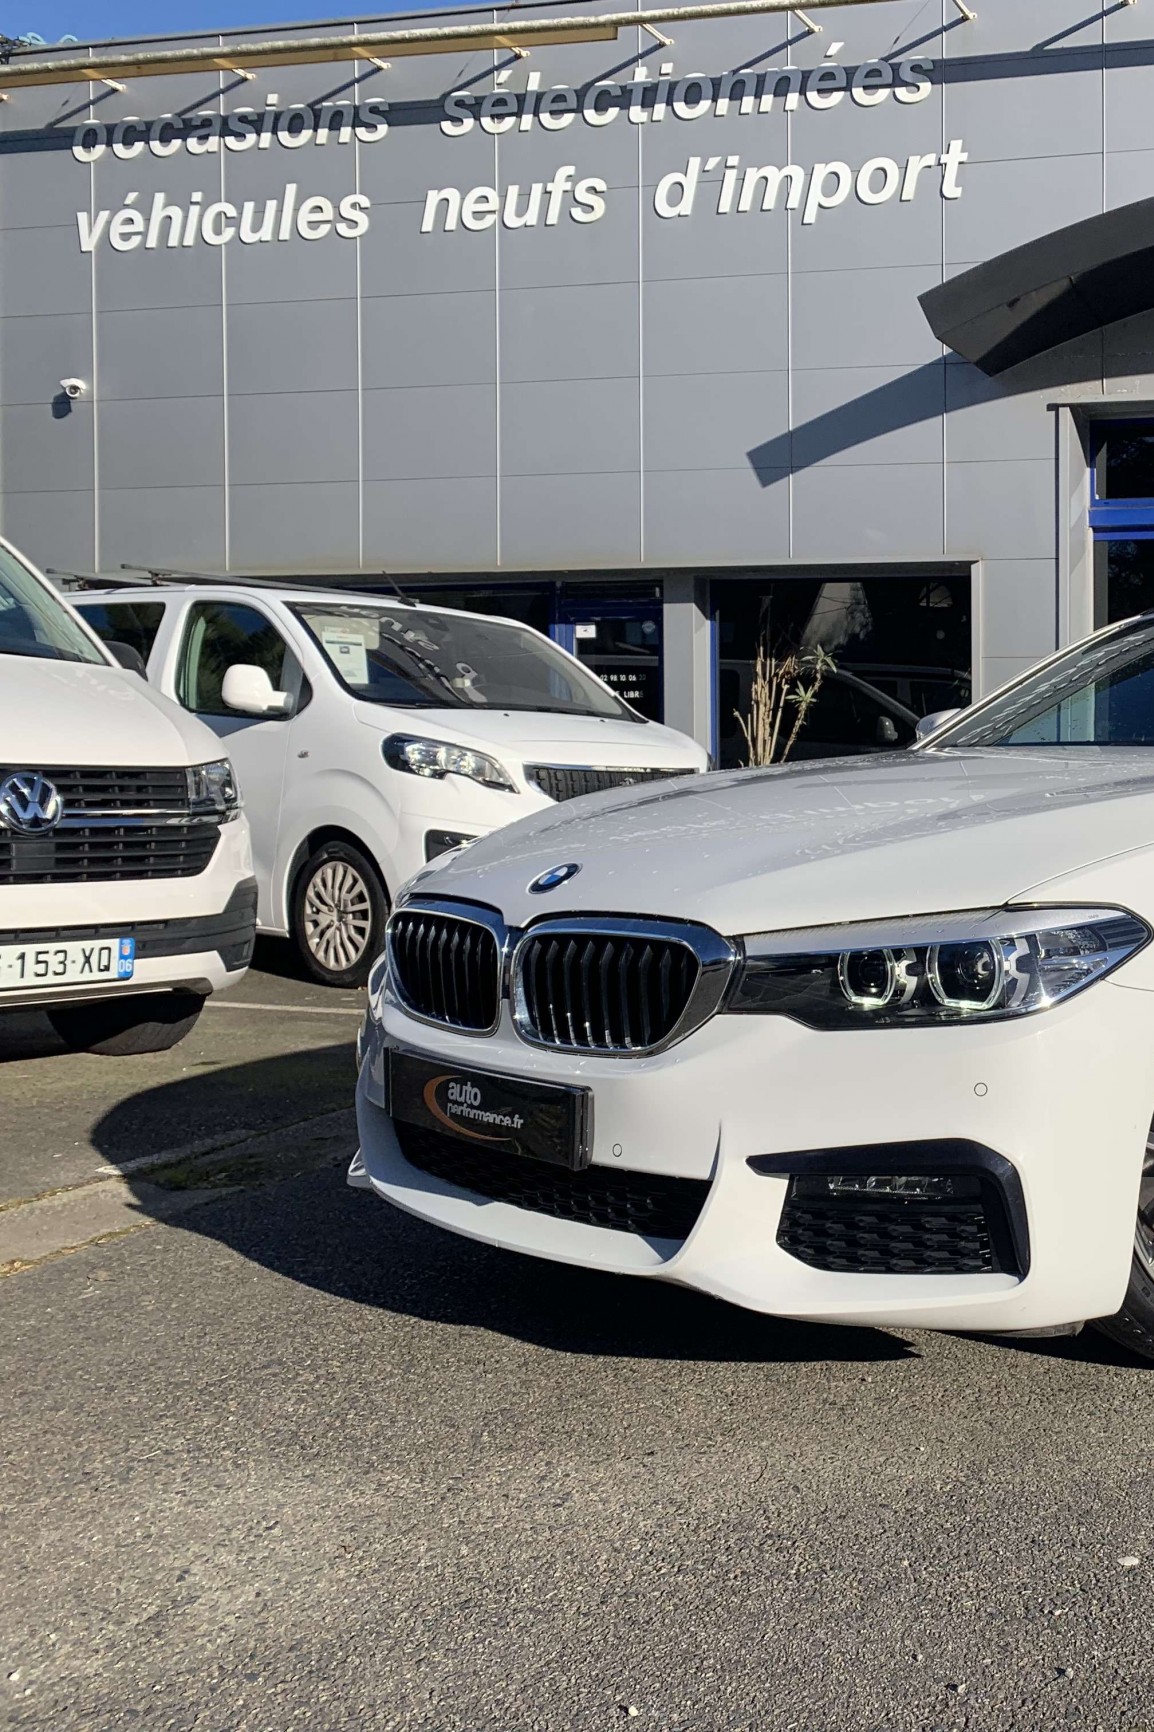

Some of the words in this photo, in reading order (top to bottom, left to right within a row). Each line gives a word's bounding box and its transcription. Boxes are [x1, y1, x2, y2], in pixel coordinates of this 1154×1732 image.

[71, 93, 390, 163] occasions
[439, 41, 935, 137] sélectionnées
[76, 182, 372, 252] véhicules
[420, 165, 609, 234] neufs
[0, 946, 112, 979] -153-XQ
[118, 958, 133, 973] 06
[447, 1081, 482, 1107] auto
